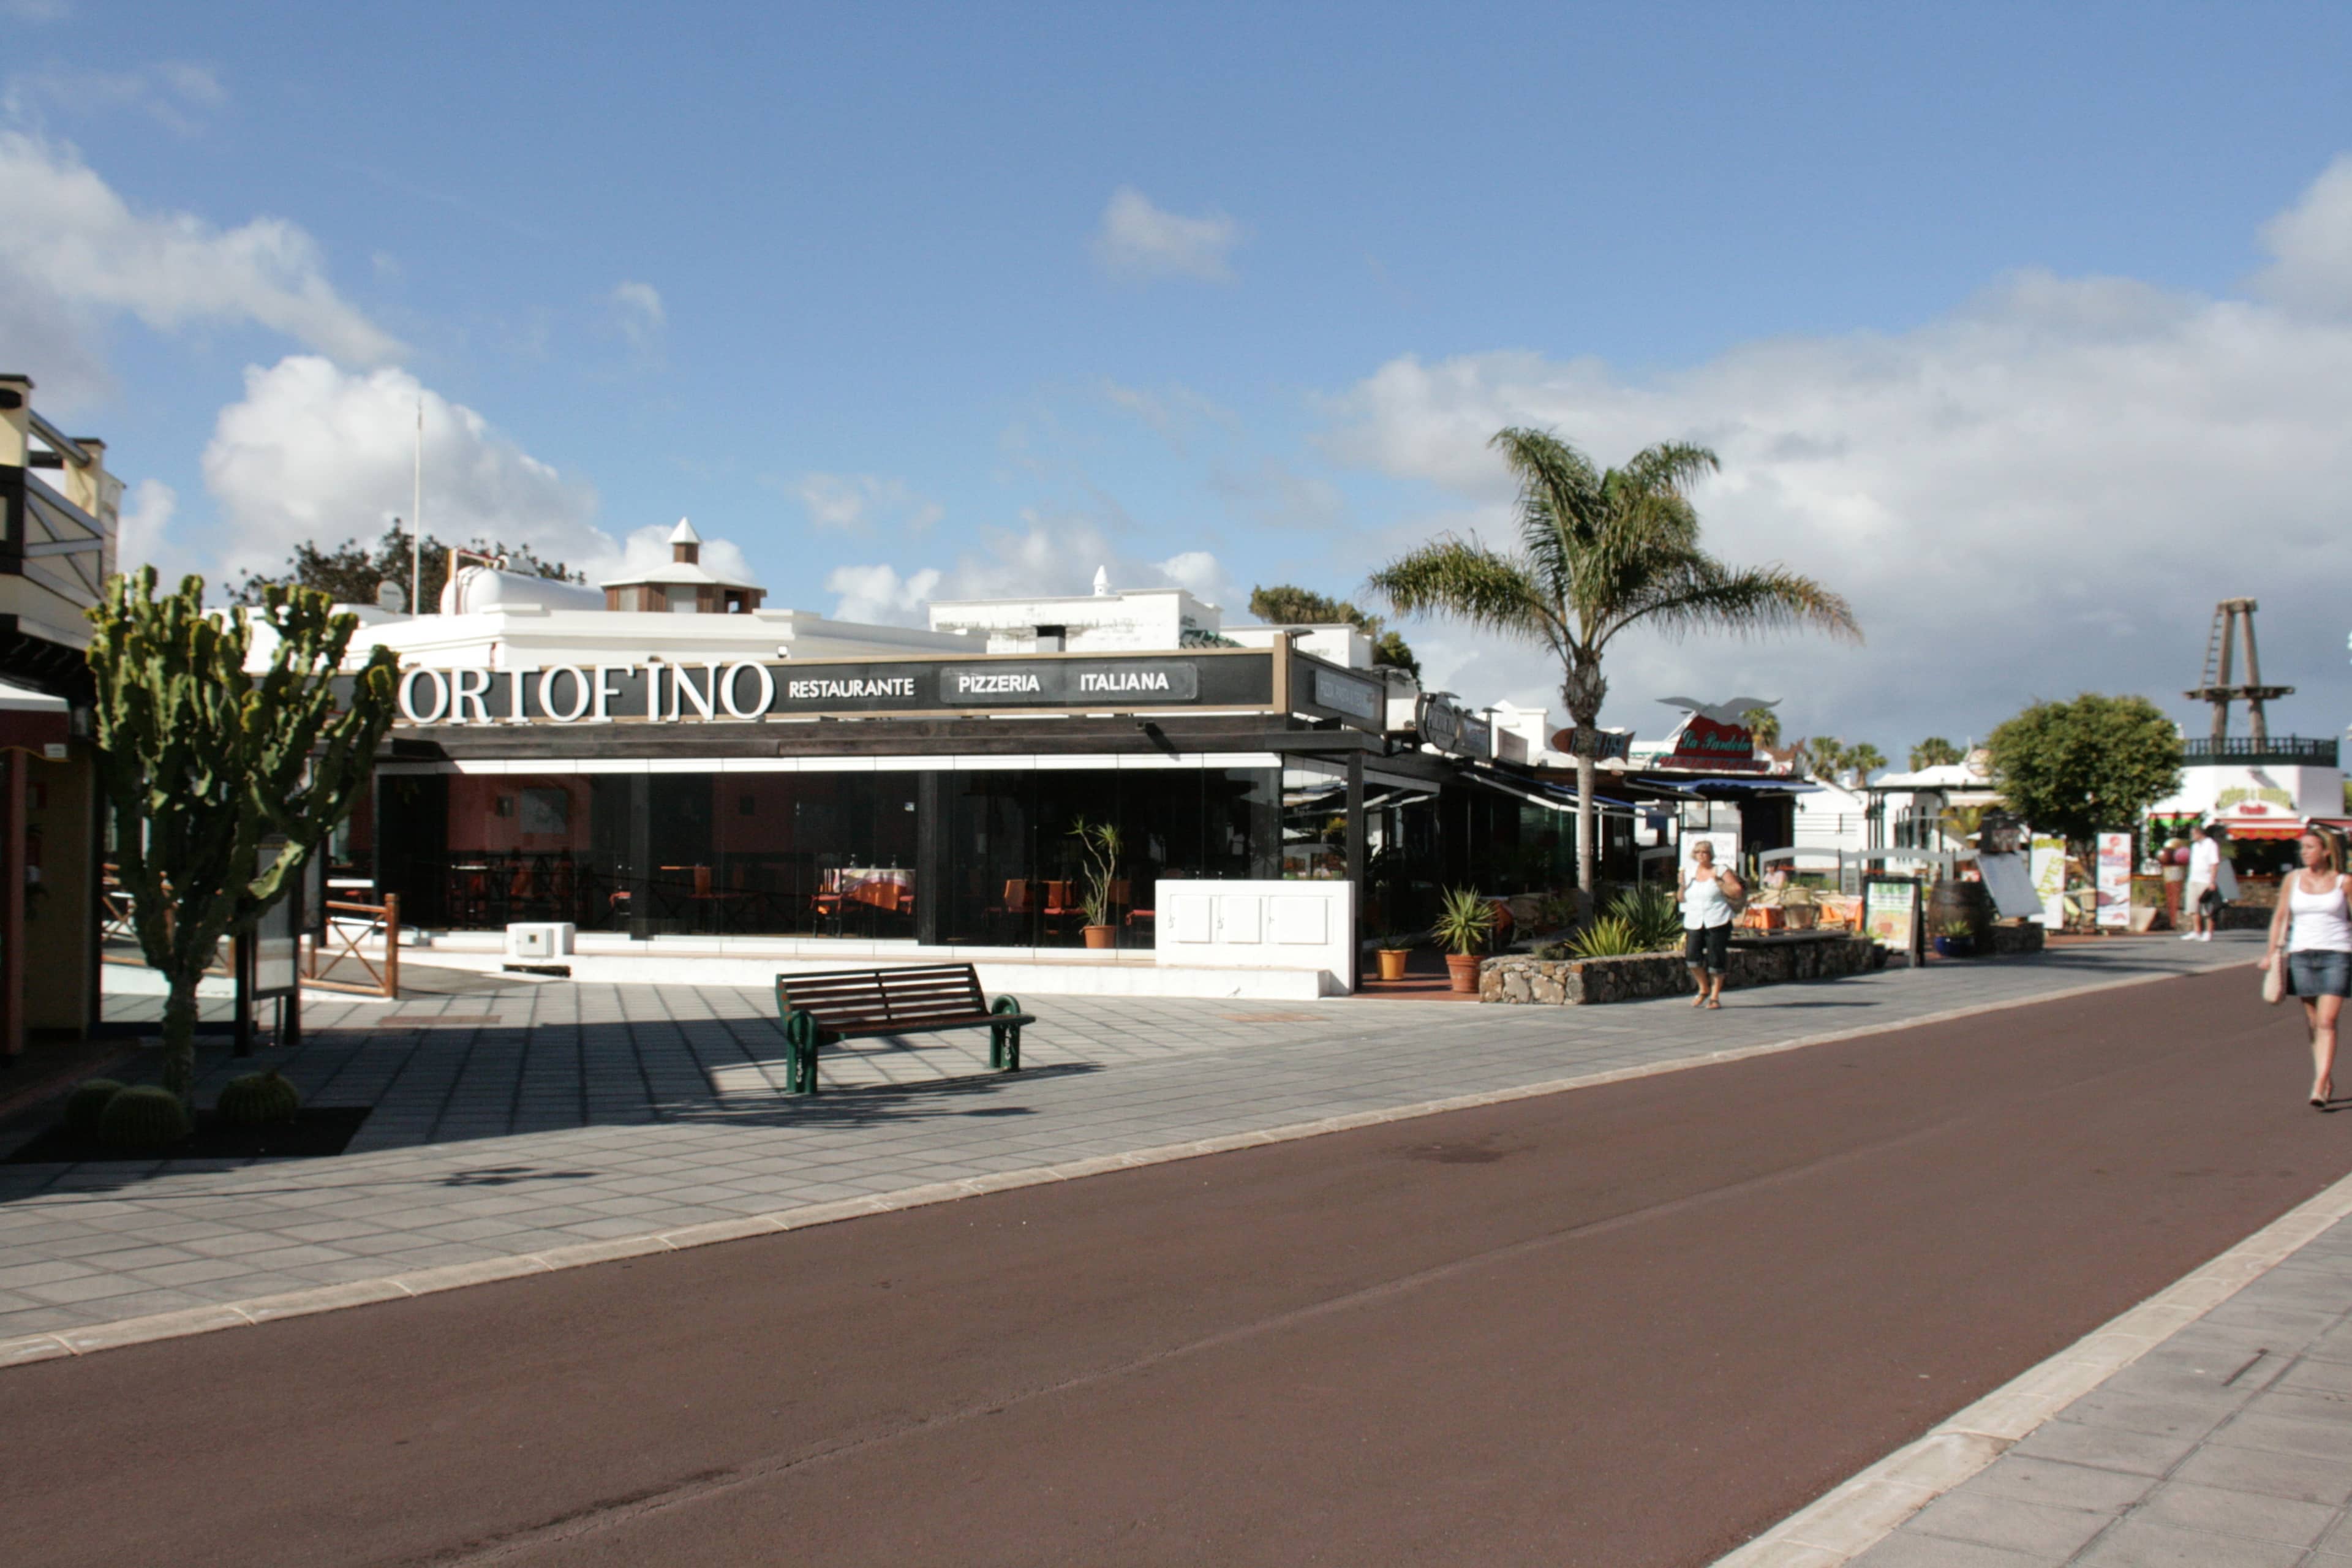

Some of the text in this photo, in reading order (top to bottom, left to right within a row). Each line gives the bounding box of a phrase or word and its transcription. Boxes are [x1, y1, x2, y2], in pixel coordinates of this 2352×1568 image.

[399, 660, 775, 725] ORTOFINO
[789, 673, 1169, 698] RESTAURANTE PIZZERIA ITALIANA
